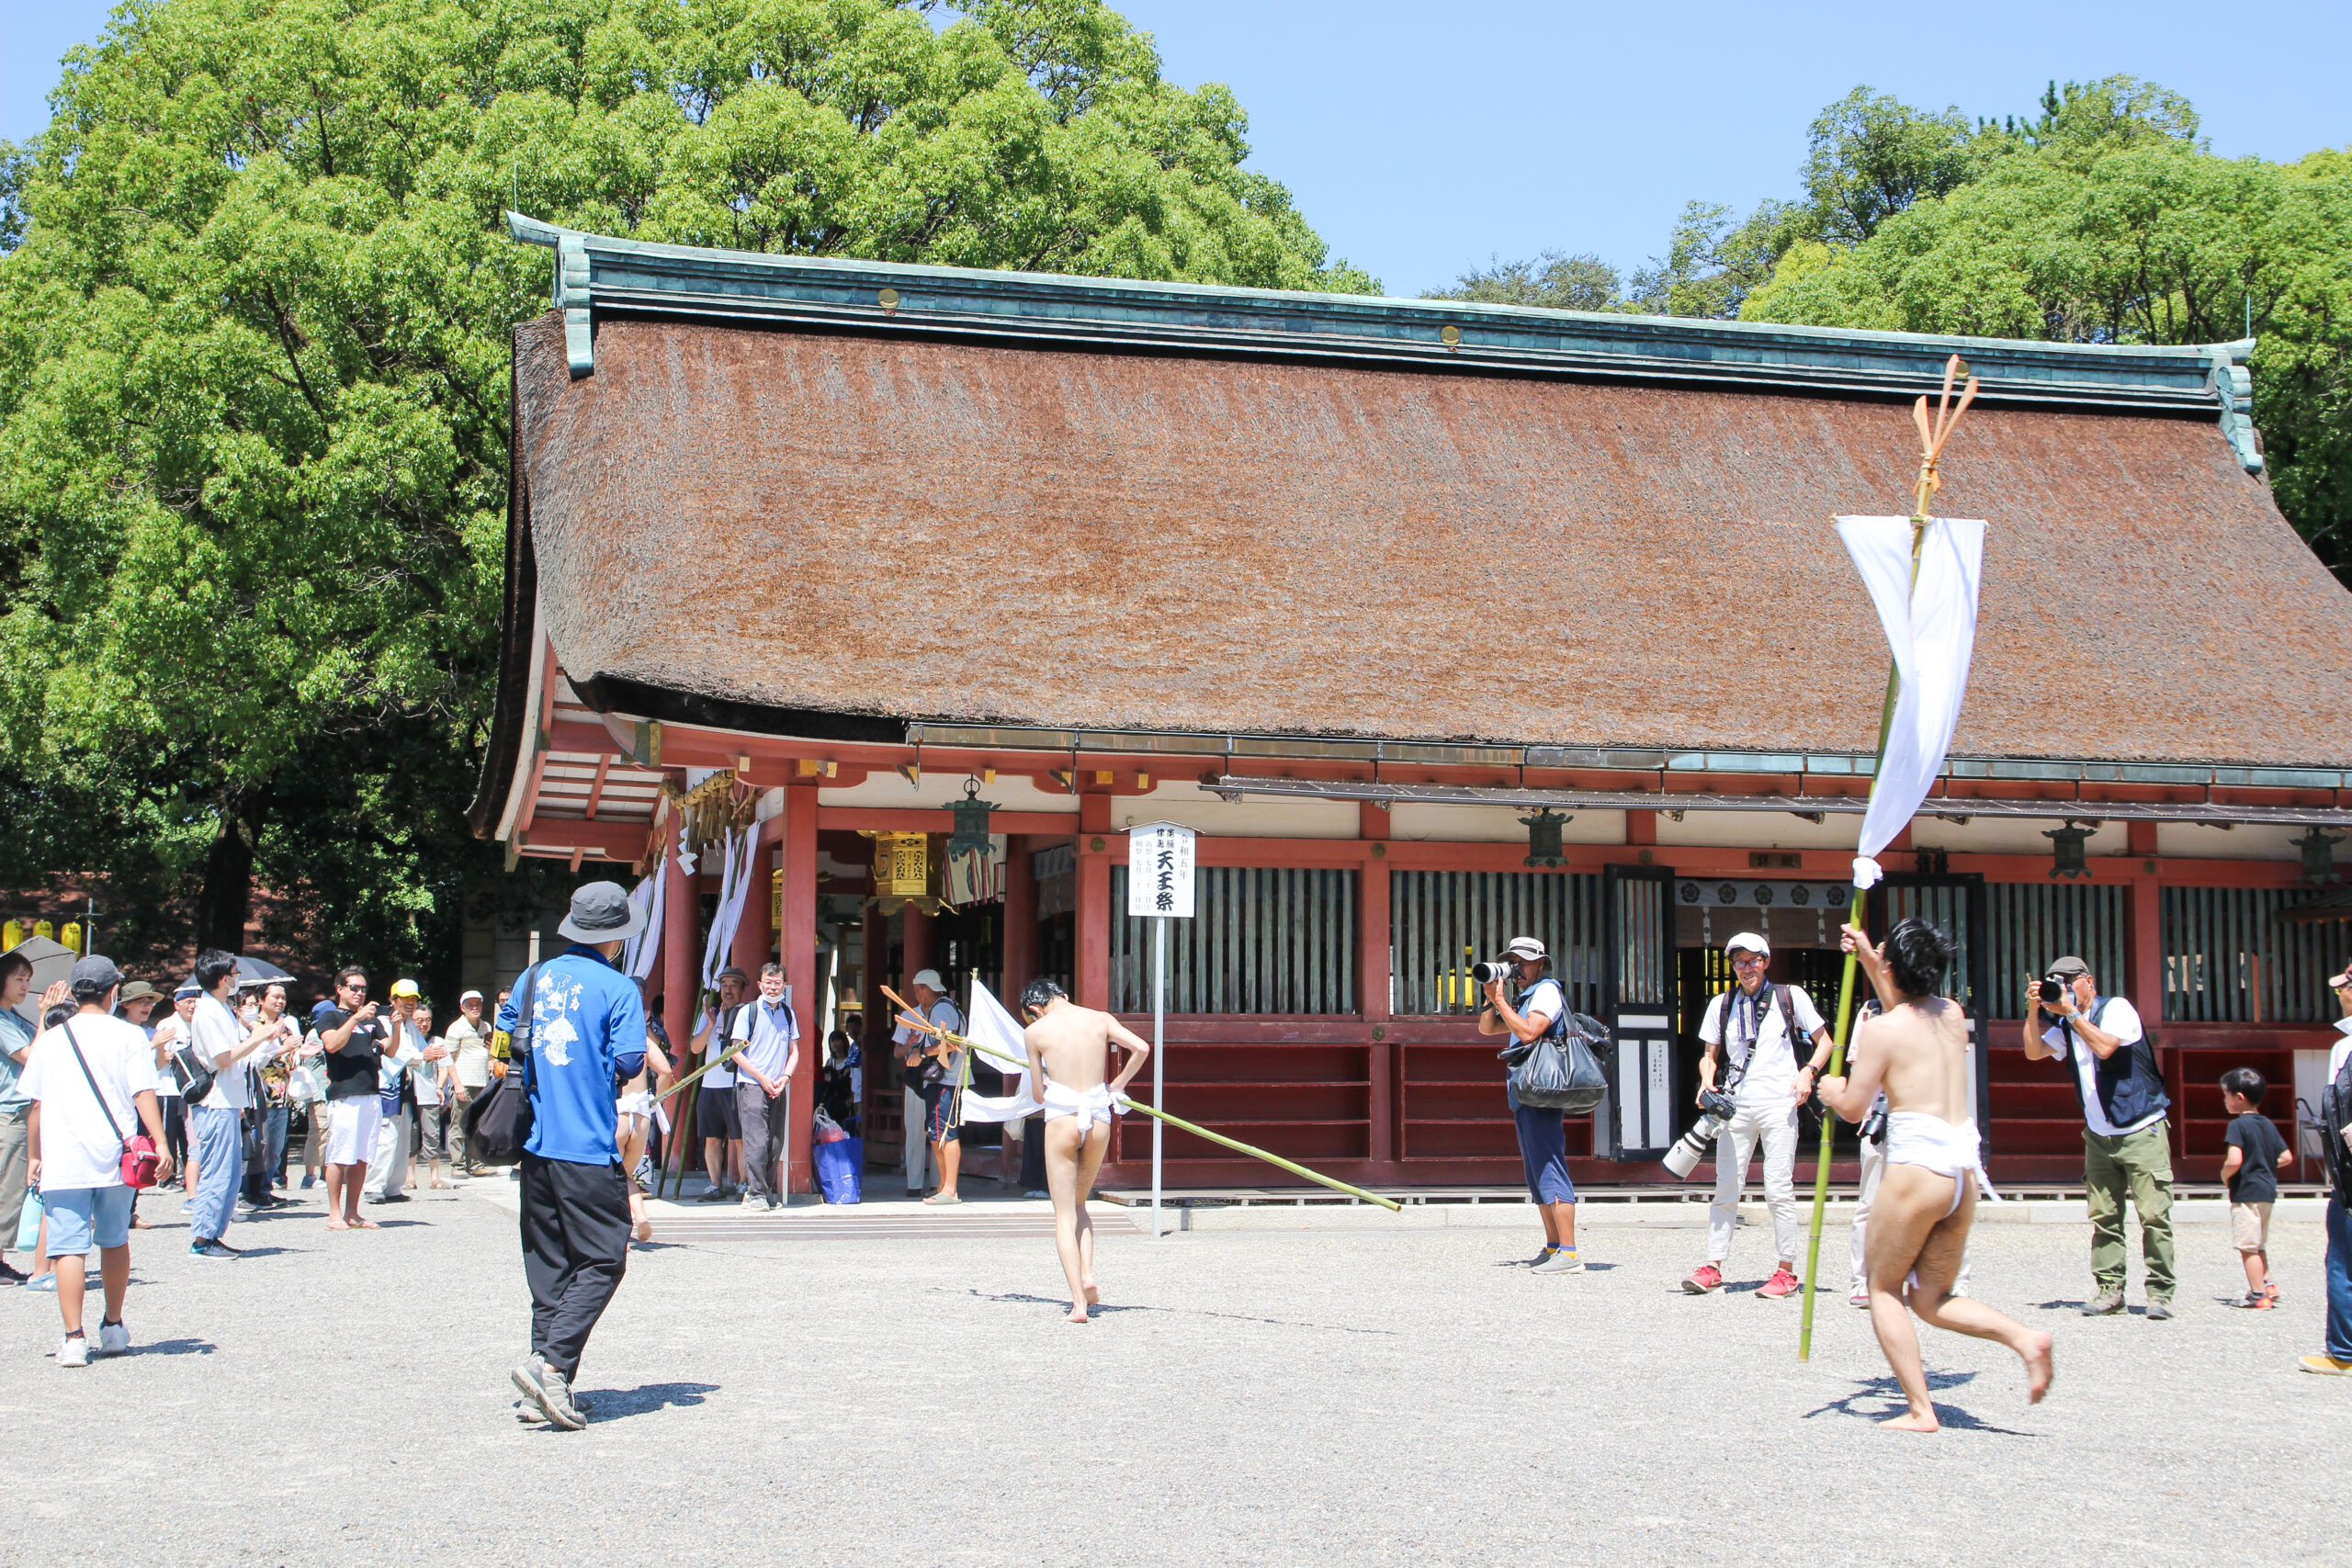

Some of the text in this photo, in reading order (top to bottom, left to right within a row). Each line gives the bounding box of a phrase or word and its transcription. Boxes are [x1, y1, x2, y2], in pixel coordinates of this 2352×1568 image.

[1156, 850, 1174, 912] 天王祭
[1179, 833, 1190, 880] 令和五年
